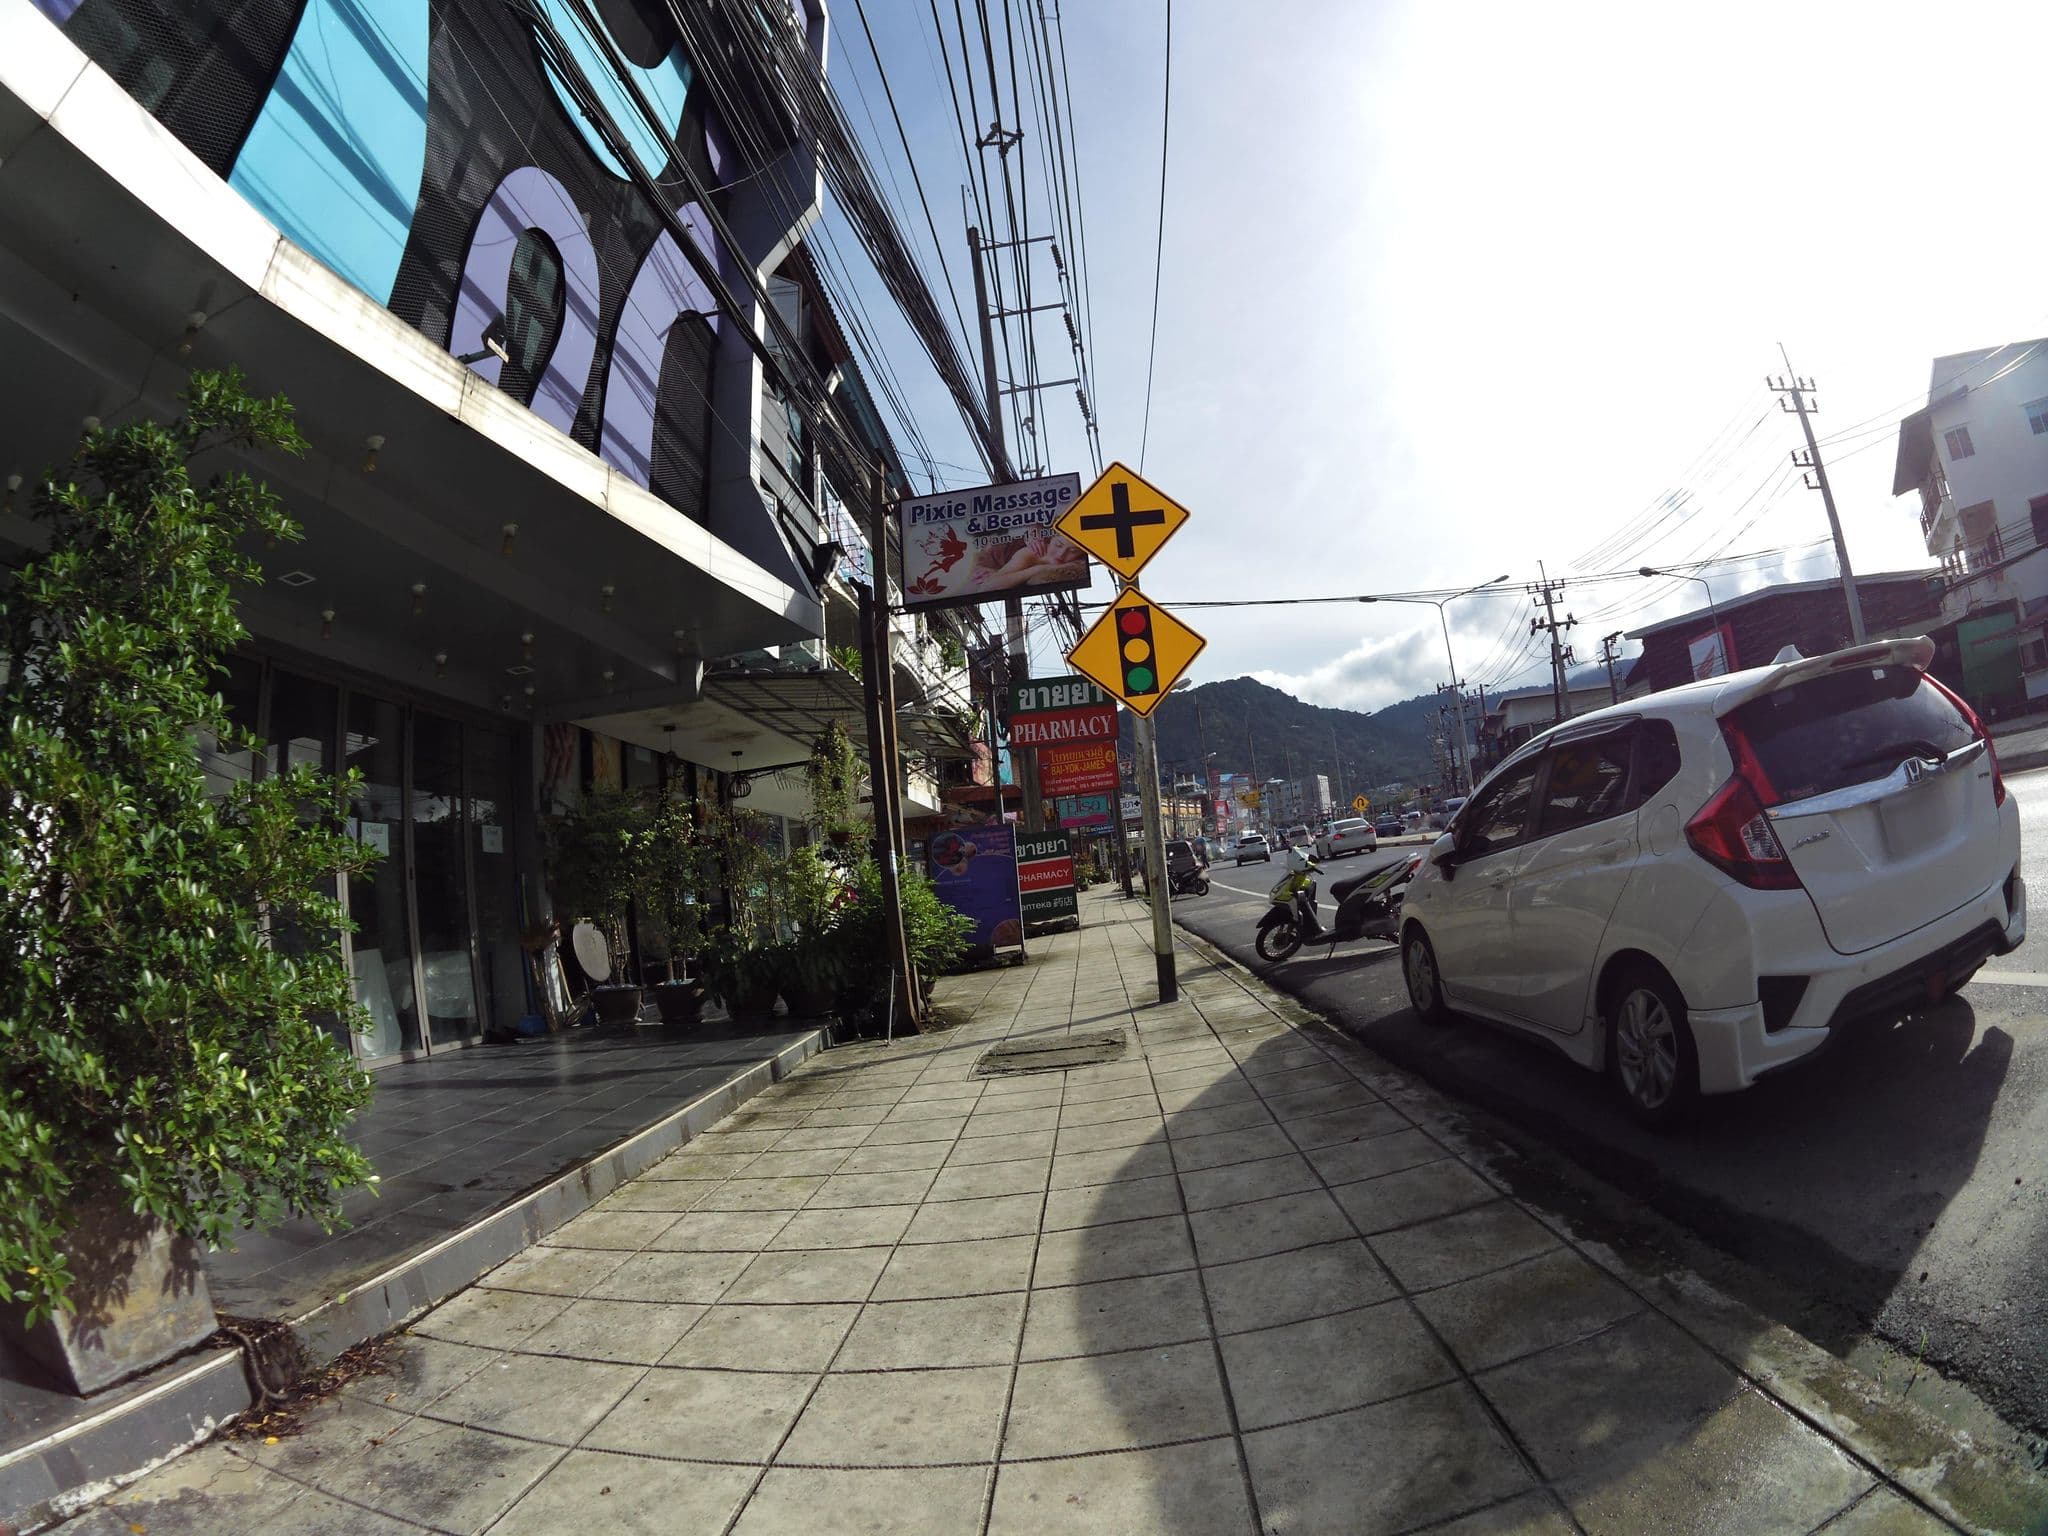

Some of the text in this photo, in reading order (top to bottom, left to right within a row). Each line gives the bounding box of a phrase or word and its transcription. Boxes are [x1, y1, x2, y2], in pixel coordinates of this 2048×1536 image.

[911, 485, 1072, 524] Pixie Massage
[967, 508, 1057, 533] & Beauty
[1018, 682, 1104, 711] ขายยา
[1013, 714, 1112, 744] PHARMACY
[1016, 838, 1068, 858] ขายยา
[1018, 868, 1070, 882] PHARMACY
